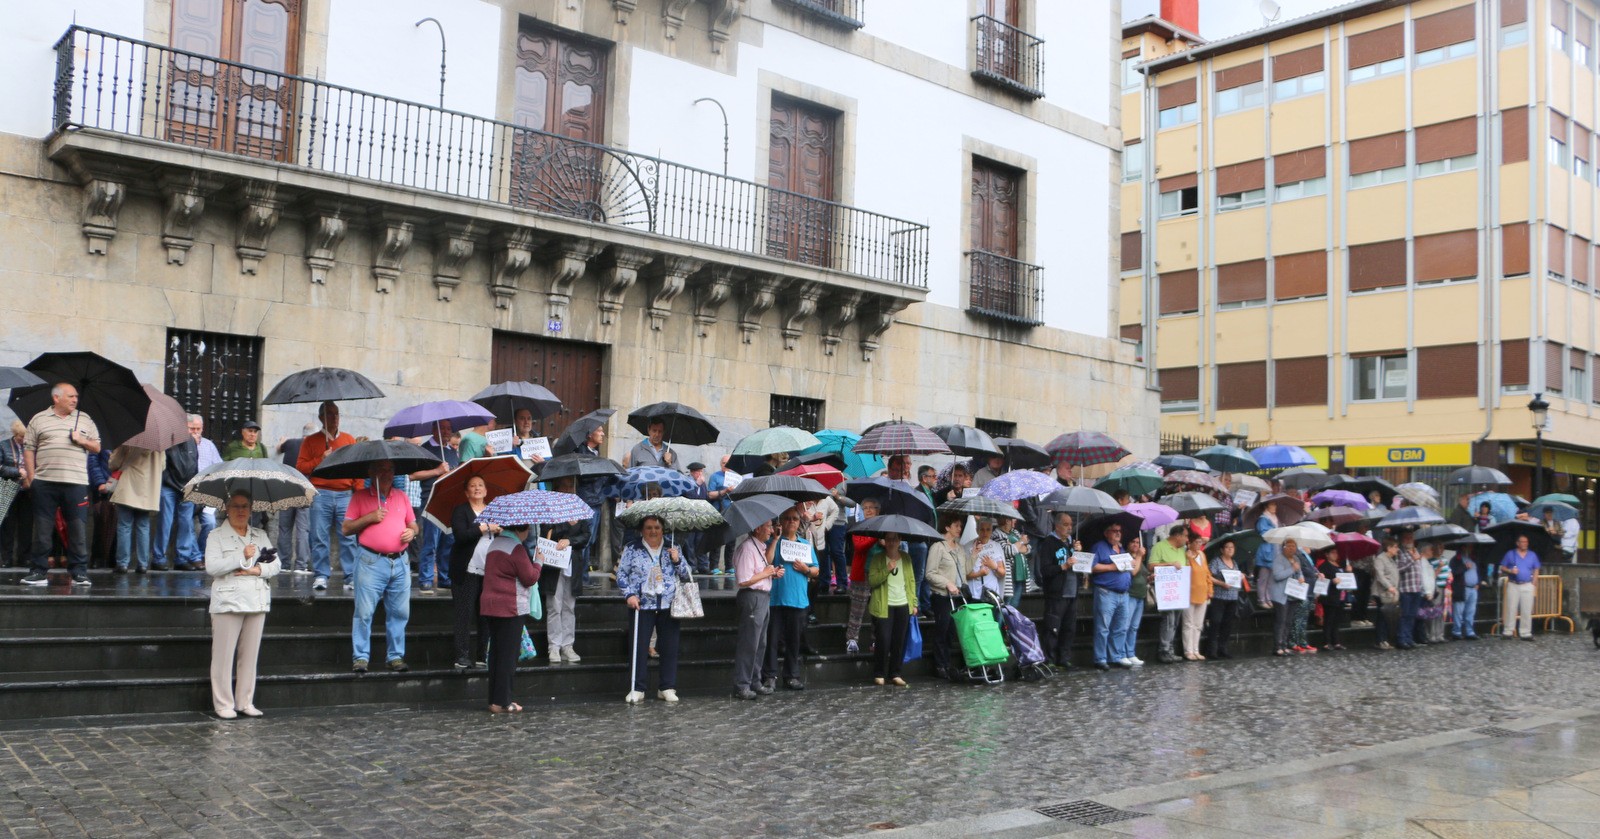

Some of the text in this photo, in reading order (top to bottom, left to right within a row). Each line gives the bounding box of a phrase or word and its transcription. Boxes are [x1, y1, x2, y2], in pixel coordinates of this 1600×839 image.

[549, 320, 561, 330] 43
[781, 541, 808, 551] PENTSIO
[782, 549, 807, 558] DUINEN
